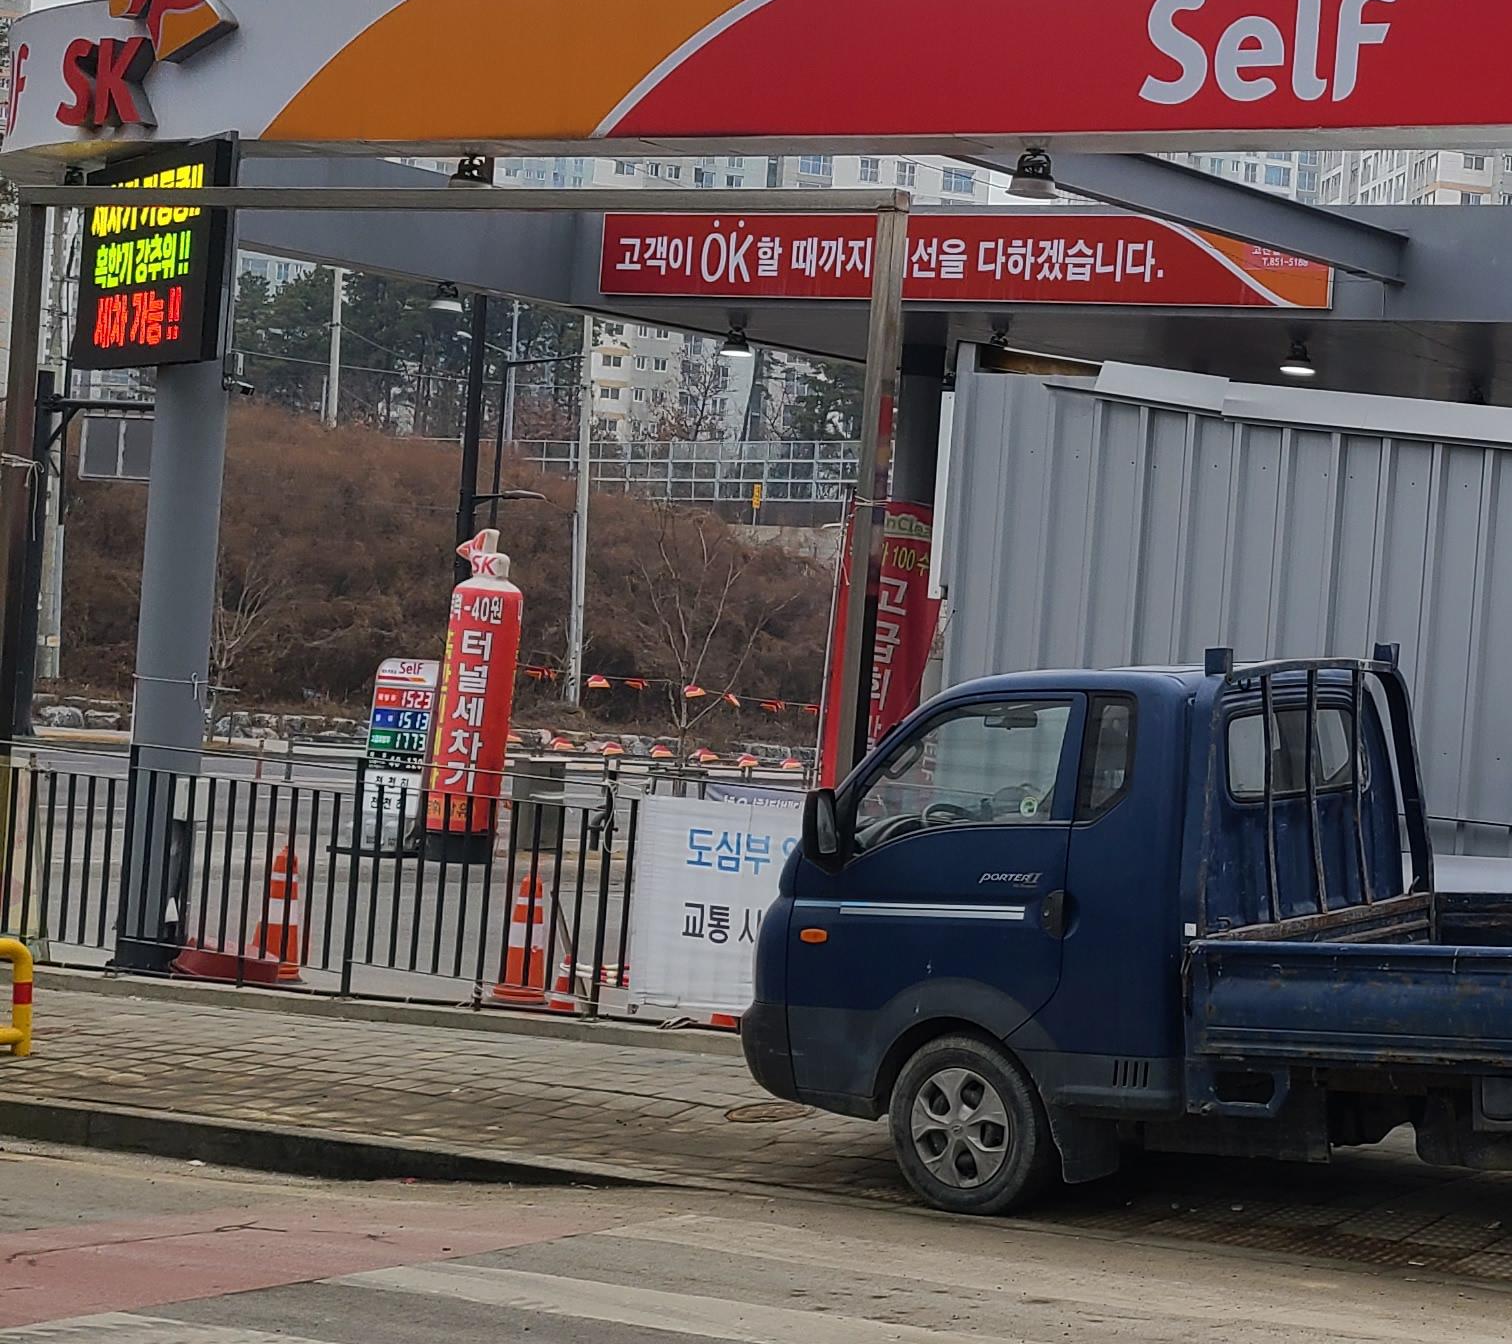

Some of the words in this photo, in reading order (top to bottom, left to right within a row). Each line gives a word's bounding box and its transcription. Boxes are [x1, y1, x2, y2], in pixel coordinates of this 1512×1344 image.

[56, 38, 146, 126] SK
[615, 236, 694, 276] 고객이
[791, 237, 873, 278] 때까지
[902, 237, 968, 279] 선을
[977, 239, 1165, 283] 다하겠습니다.
[94, 293, 128, 349] 세차
[472, 556, 497, 576] SK
[398, 711, 430, 730] 1513
[401, 690, 433, 709] 1523
[443, 629, 493, 793] 터널세차기
[395, 733, 426, 751] 1773
[686, 828, 771, 875] 도심부
[682, 902, 731, 944] 교통
